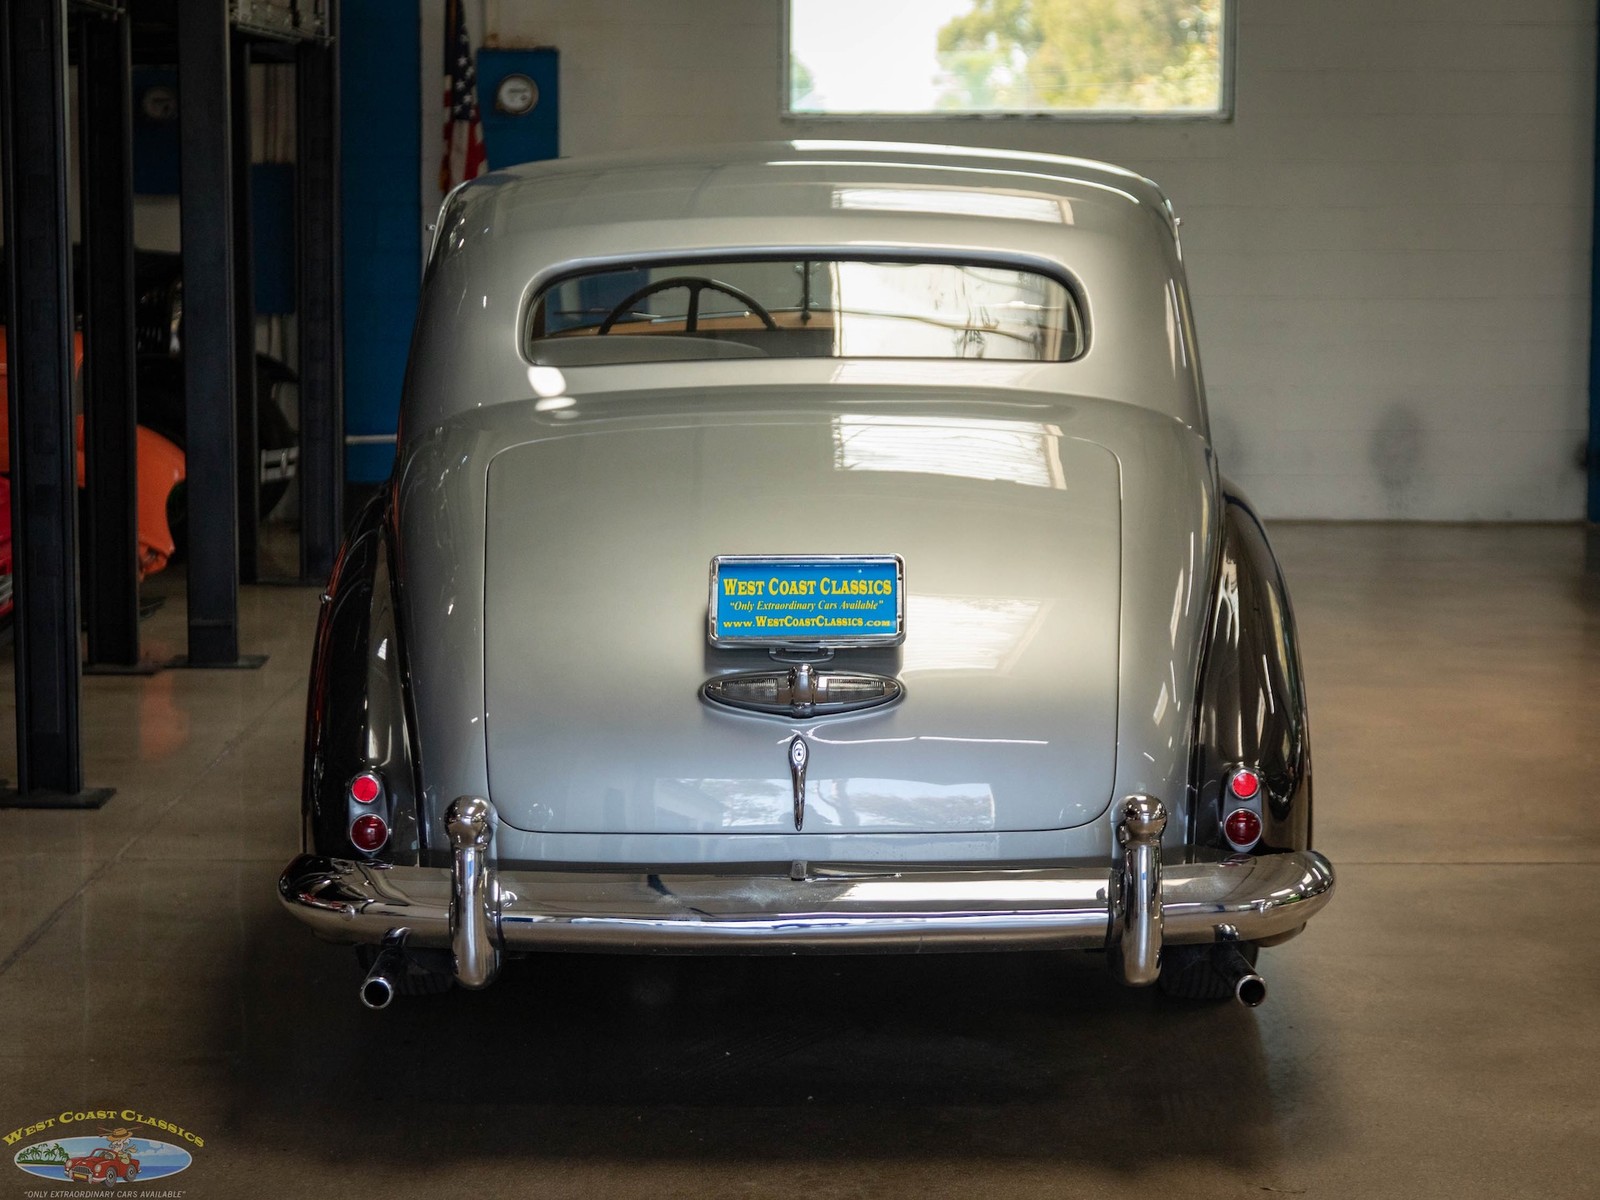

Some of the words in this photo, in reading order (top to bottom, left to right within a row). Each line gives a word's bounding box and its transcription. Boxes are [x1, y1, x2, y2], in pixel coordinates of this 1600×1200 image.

[723, 578, 765, 596] WEST
[768, 577, 817, 596] COAST
[819, 577, 892, 596] CLASSICS
[756, 600, 816, 612] Extraordinary
[817, 600, 838, 610] Cars
